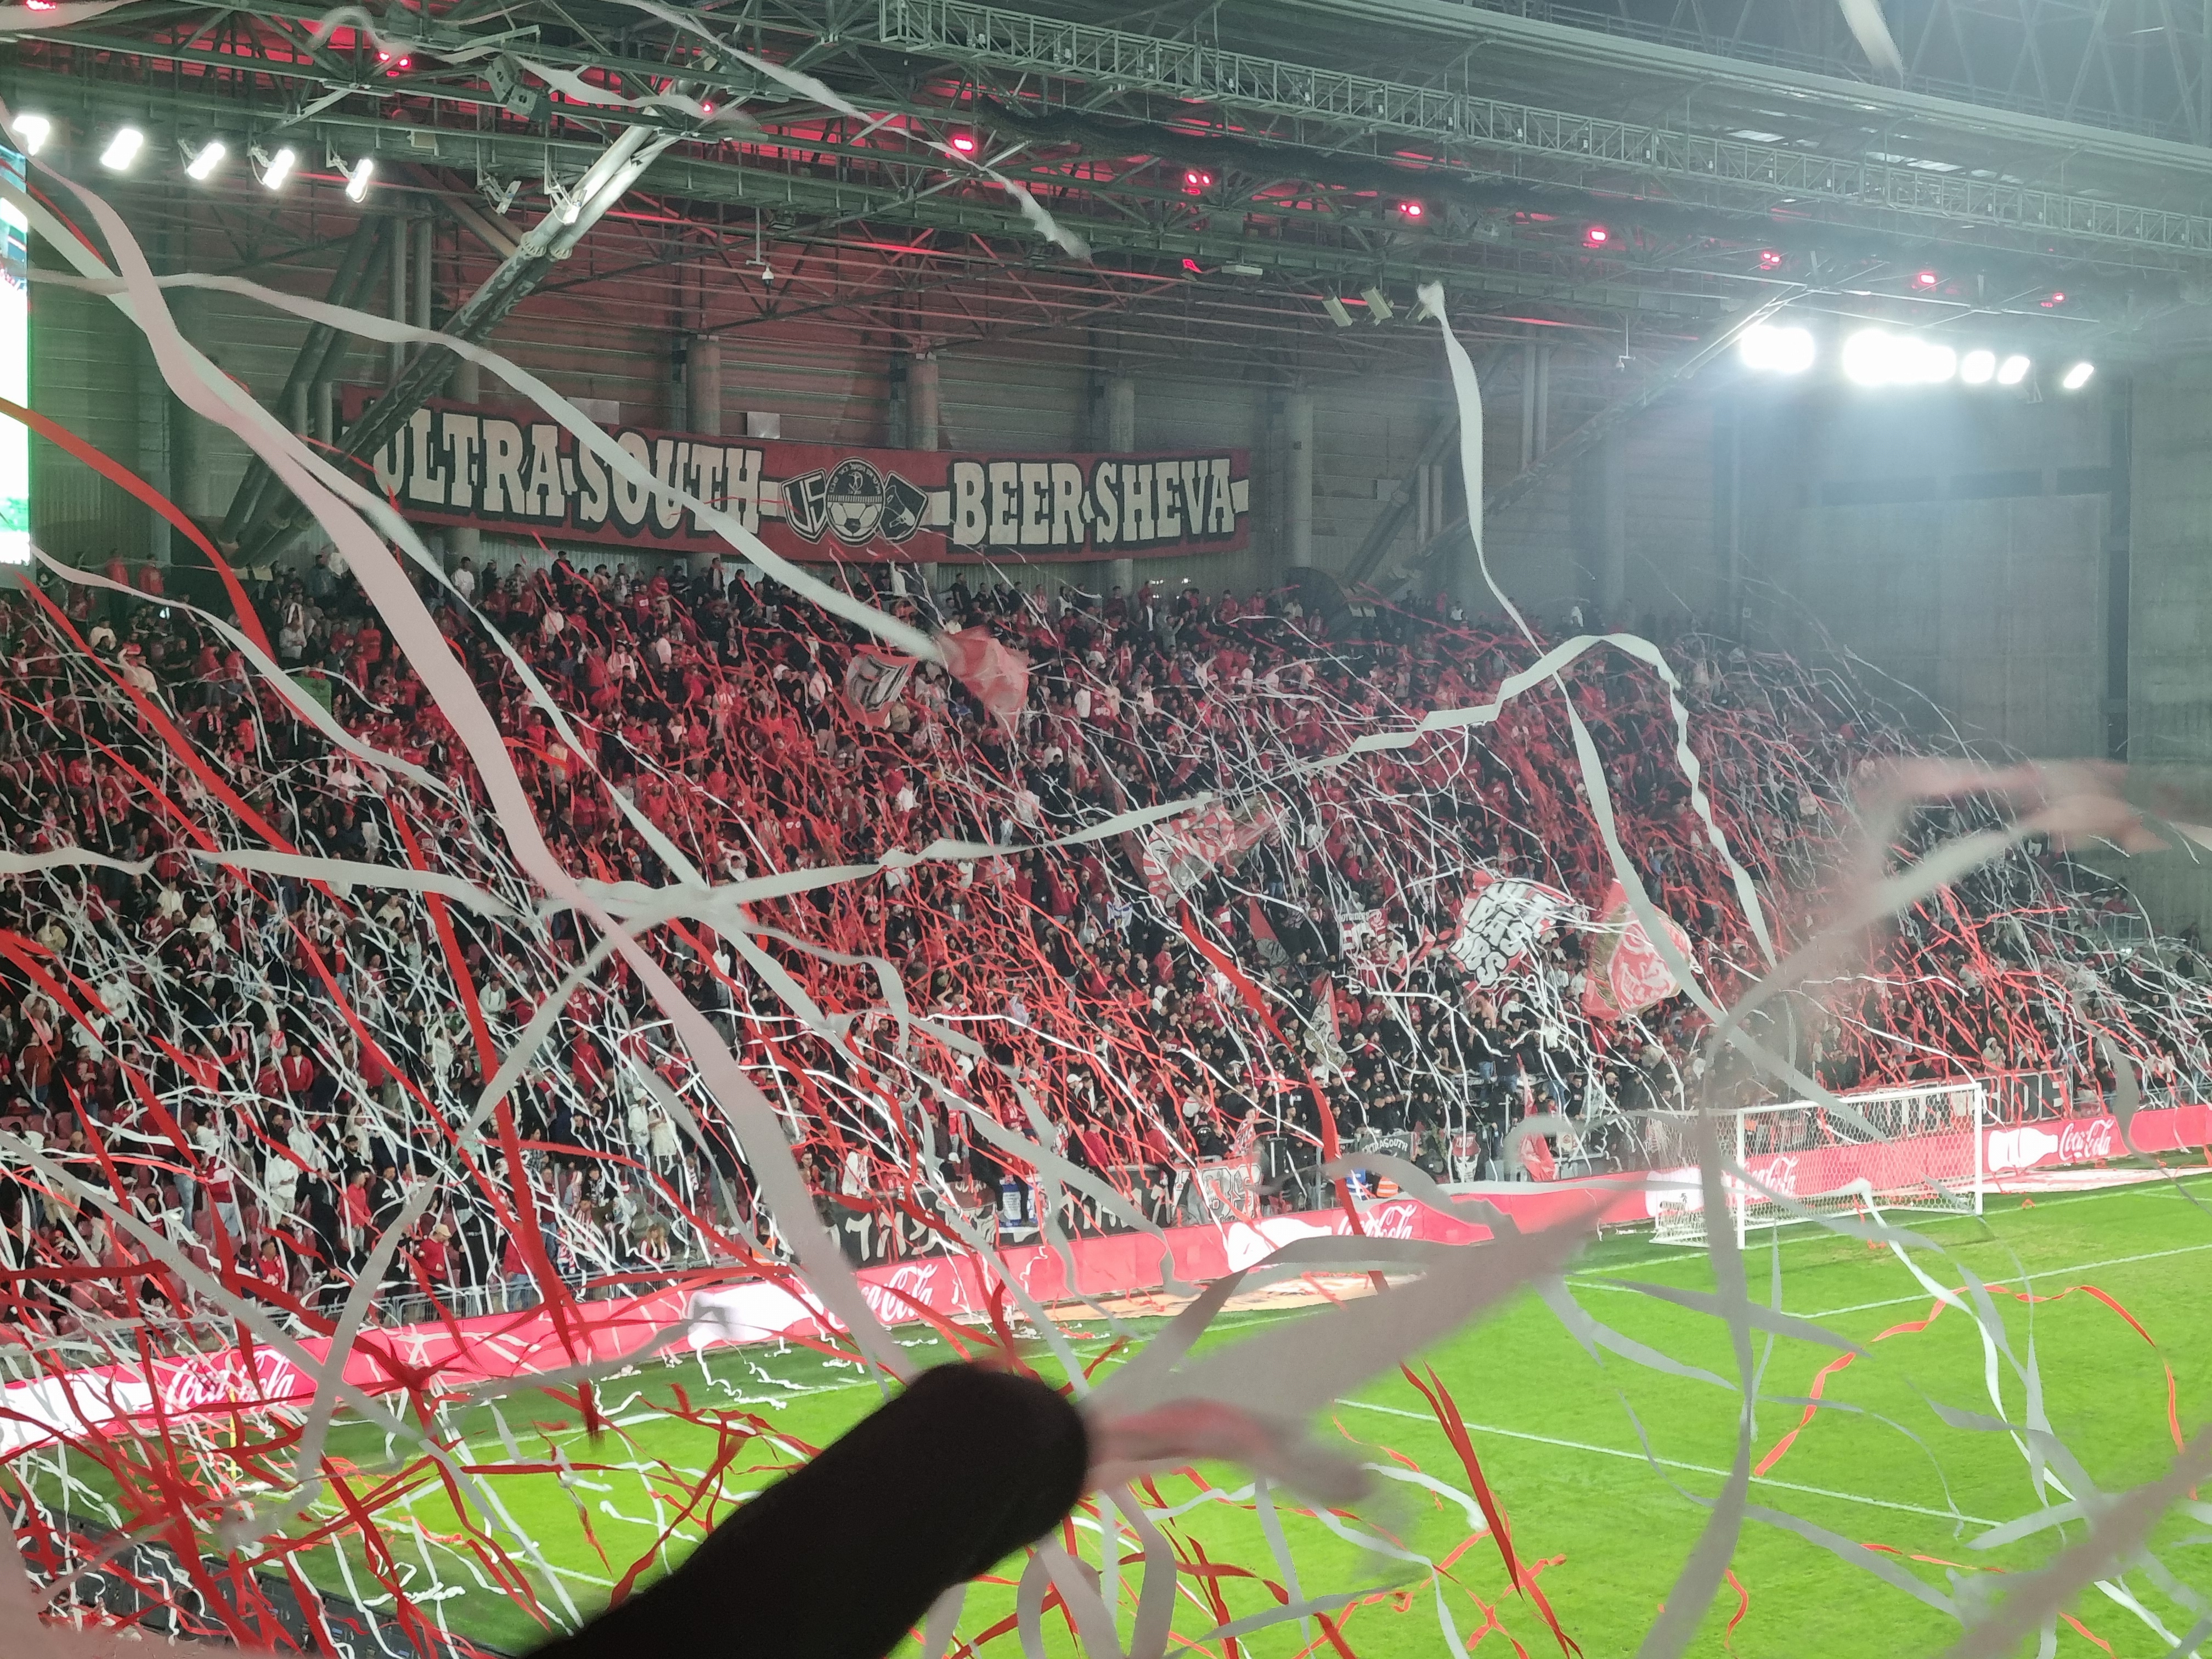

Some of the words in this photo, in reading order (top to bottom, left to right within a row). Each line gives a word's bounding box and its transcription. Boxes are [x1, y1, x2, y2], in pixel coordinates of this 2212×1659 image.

[373, 408, 565, 518] ULTRA
[579, 430, 763, 534] SOUTH
[953, 461, 1086, 545] BEER
[1096, 458, 1235, 543] SHEVA
[2059, 1119, 2114, 1161] Coca-Cola
